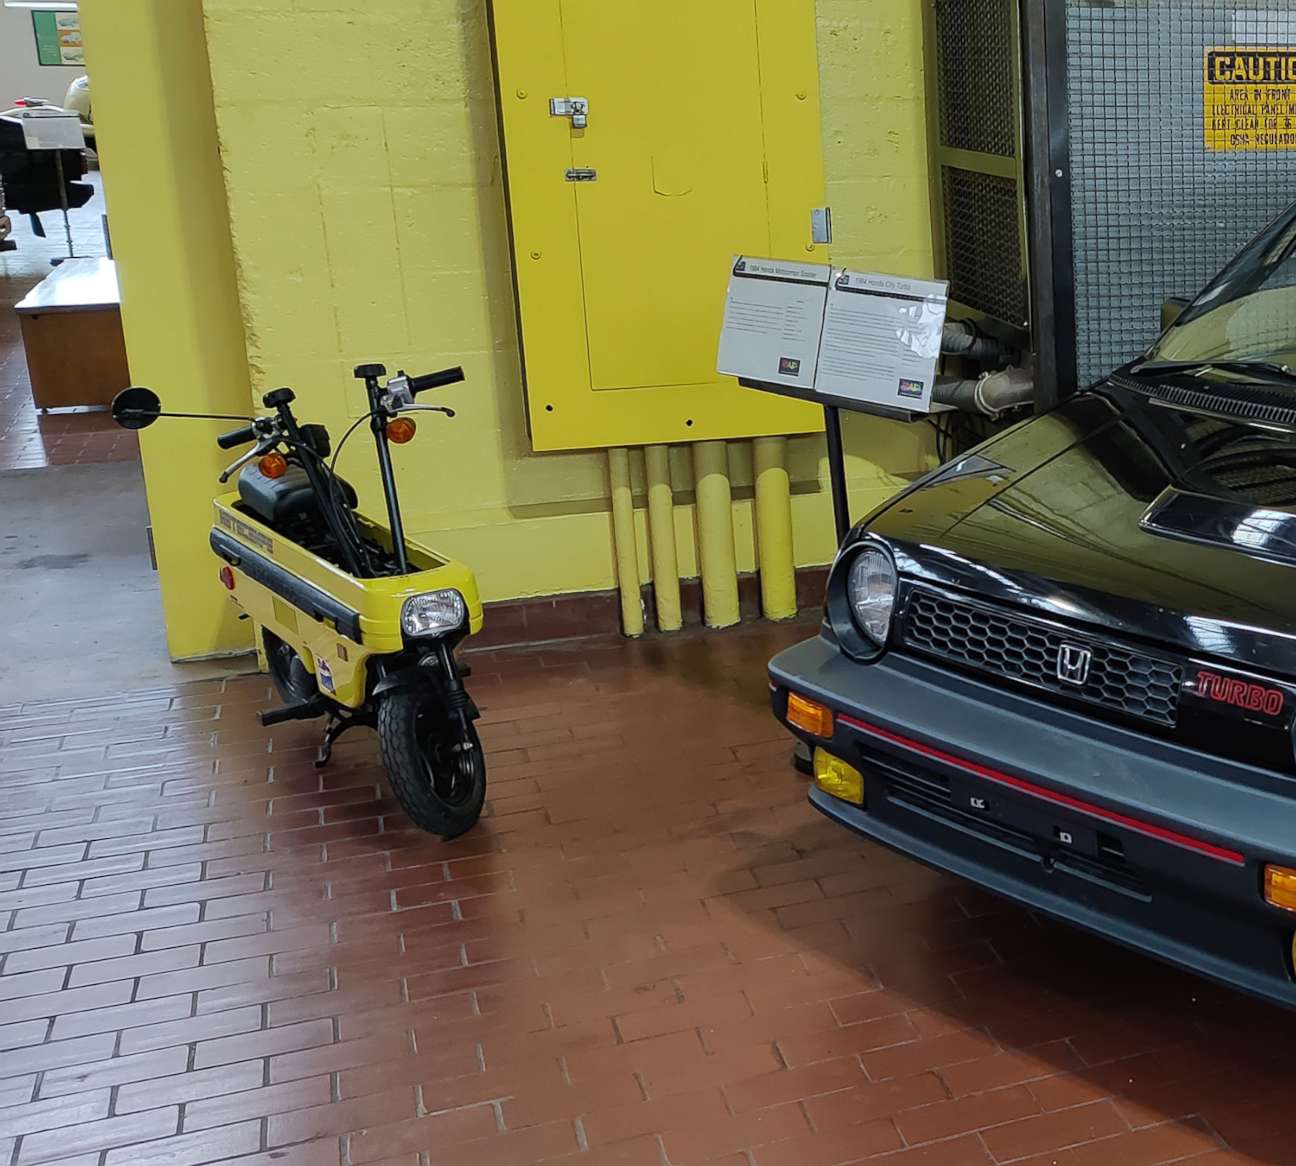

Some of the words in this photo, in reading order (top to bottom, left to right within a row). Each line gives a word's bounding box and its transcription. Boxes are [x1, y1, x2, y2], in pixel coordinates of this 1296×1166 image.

[1230, 89, 1249, 101] AREA
[1266, 89, 1291, 101] FRONT
[1212, 104, 1257, 116] ELECTRICAL
[1262, 104, 1284, 115] PANEL
[1212, 118, 1231, 130] KEPT
[1235, 118, 1259, 130] CLEAR
[1264, 118, 1277, 129] FOR
[1230, 133, 1250, 146] OSHA
[1197, 671, 1285, 716] TURBO
